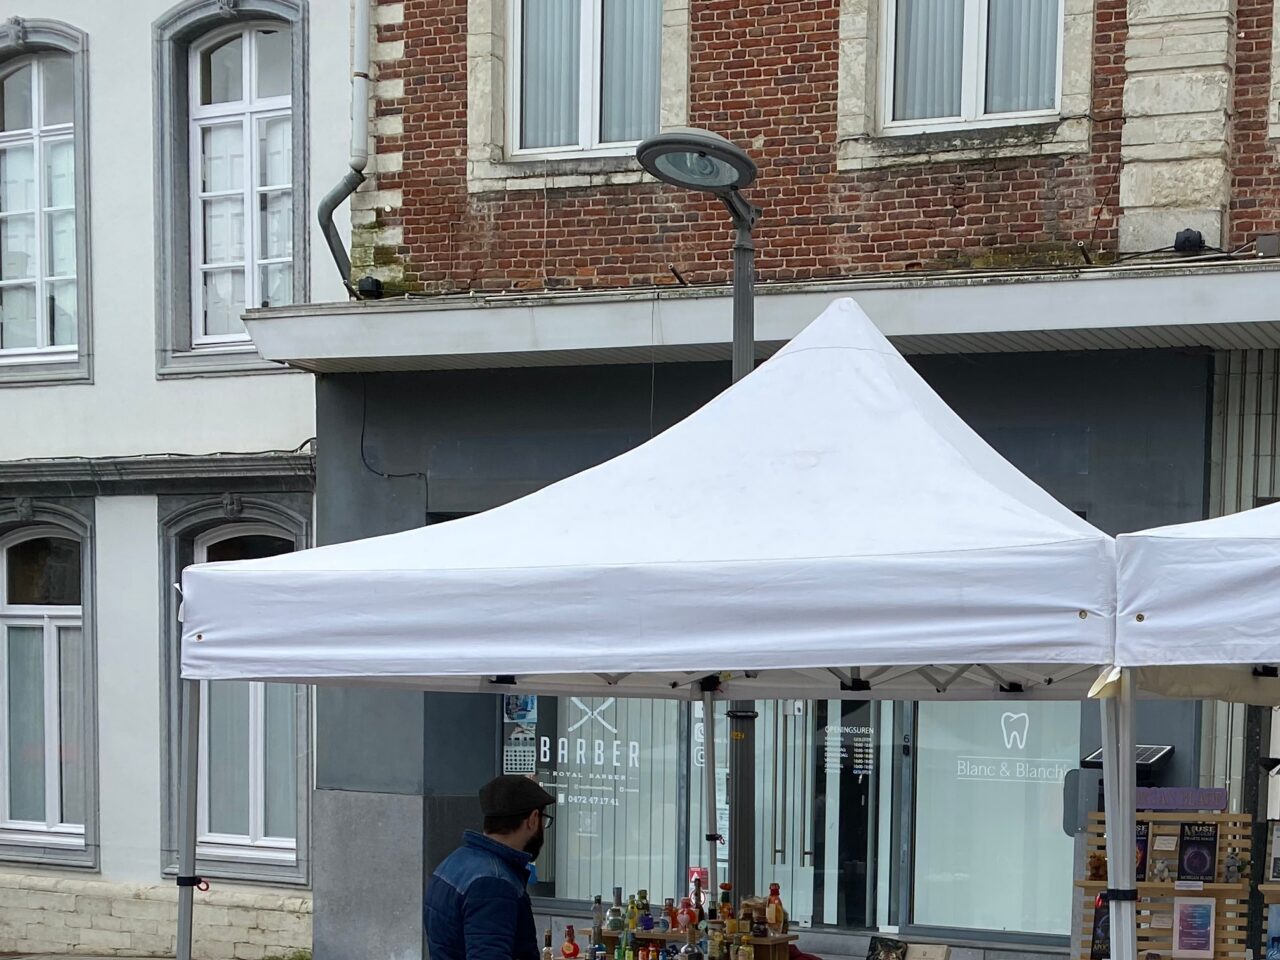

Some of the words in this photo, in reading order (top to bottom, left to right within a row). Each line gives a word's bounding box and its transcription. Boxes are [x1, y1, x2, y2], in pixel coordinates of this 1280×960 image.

[540, 736, 640, 767] BARBER
[957, 760, 996, 776] Blanc
[1000, 762, 1010, 777] &
[568, 795, 587, 804] 0472
[588, 796, 599, 804] 47
[610, 798, 620, 806] 41
